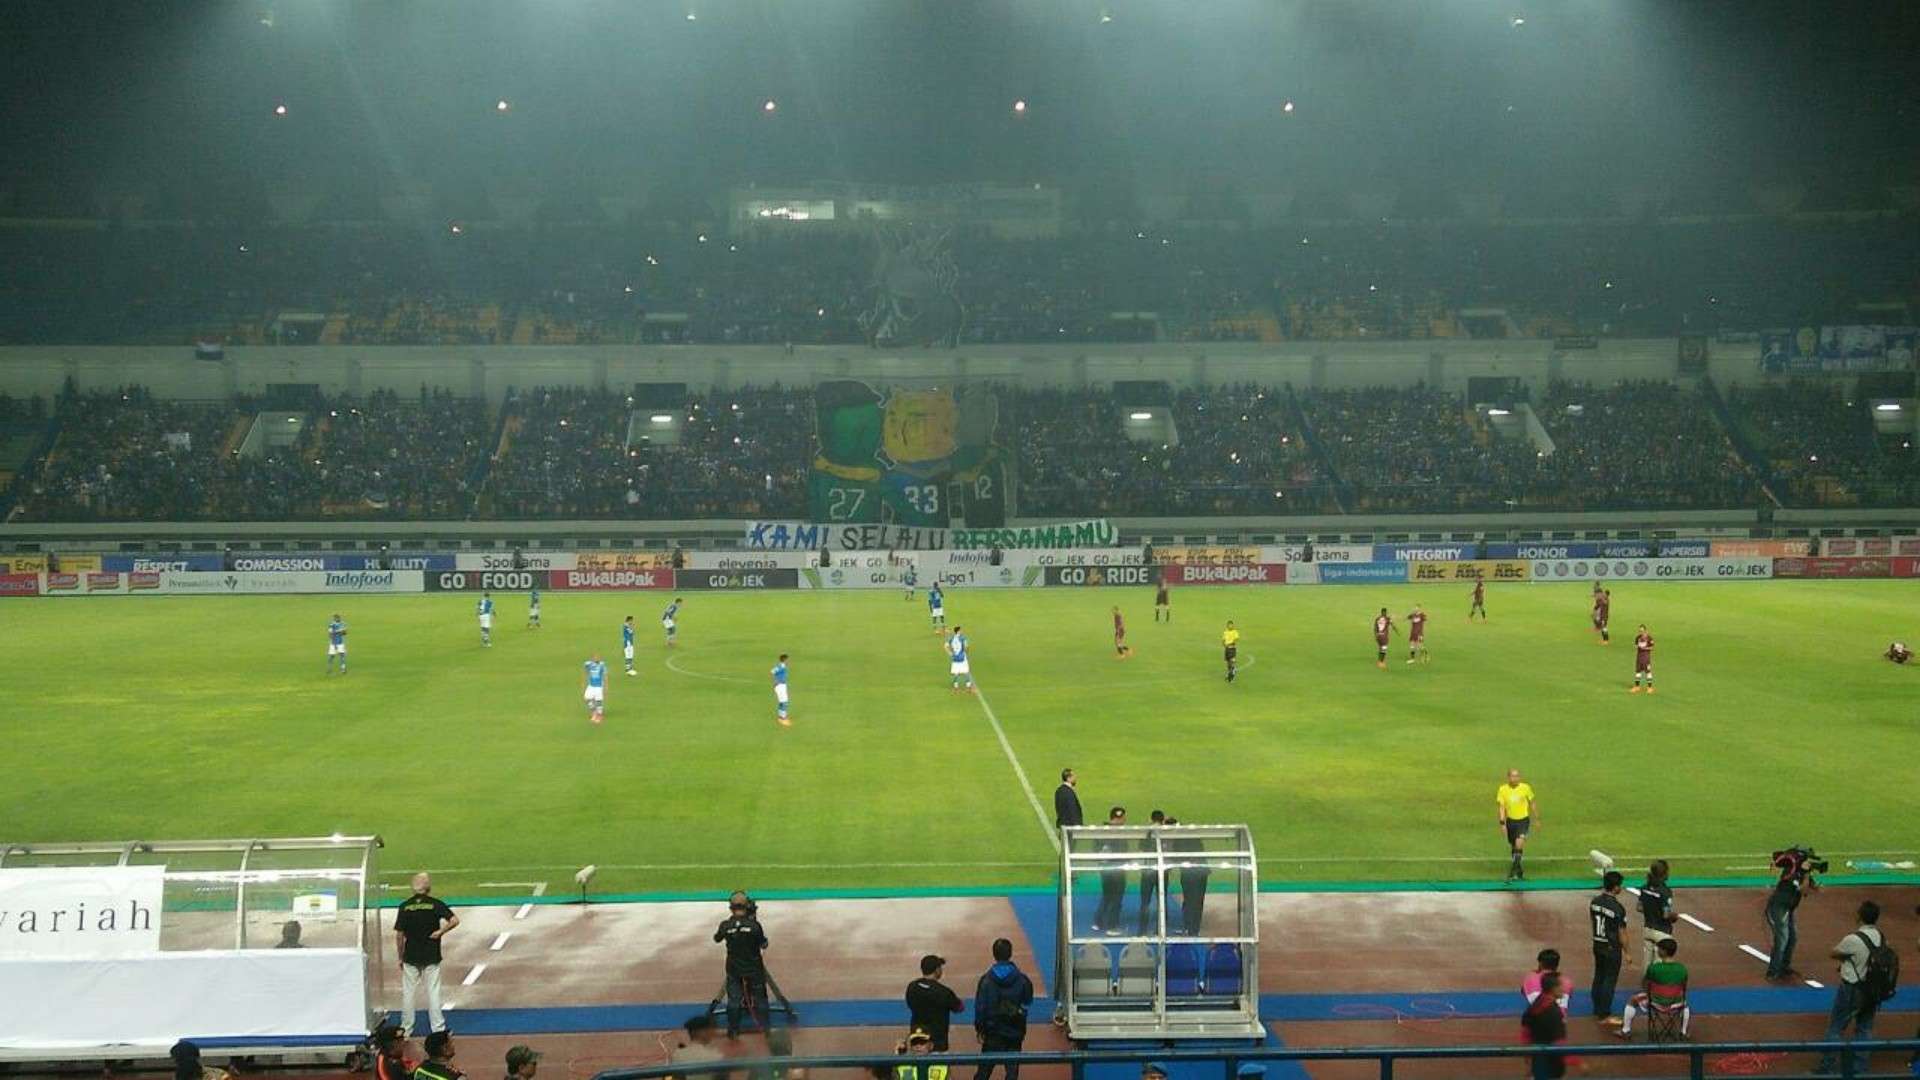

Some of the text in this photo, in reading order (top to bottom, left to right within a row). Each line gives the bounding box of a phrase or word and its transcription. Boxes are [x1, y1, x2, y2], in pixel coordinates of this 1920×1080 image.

[973, 475, 992, 500] 12
[828, 488, 865, 520] 27
[904, 485, 938, 514] 33
[840, 525, 945, 550] SELALU
[1395, 549, 1462, 561] INTEGRITY
[1516, 548, 1568, 559] HONOR
[133, 560, 189, 572] RESPECT
[234, 559, 324, 571] COMPASSION
[719, 557, 778, 568] elevenia
[866, 558, 883, 568] GO
[1038, 555, 1085, 565] GO JEK
[1093, 555, 1140, 565] GO JEK
[1060, 567, 1149, 584] GO RIDE
[1656, 565, 1705, 576] GO JEK
[1718, 564, 1734, 575] GO
[1746, 564, 1767, 575] JEK
[325, 572, 393, 590] Indofood
[440, 572, 533, 589] GO FOOD
[709, 575, 765, 588] GO JEK
[871, 573, 886, 583] GO
[938, 571, 964, 585] Liga
